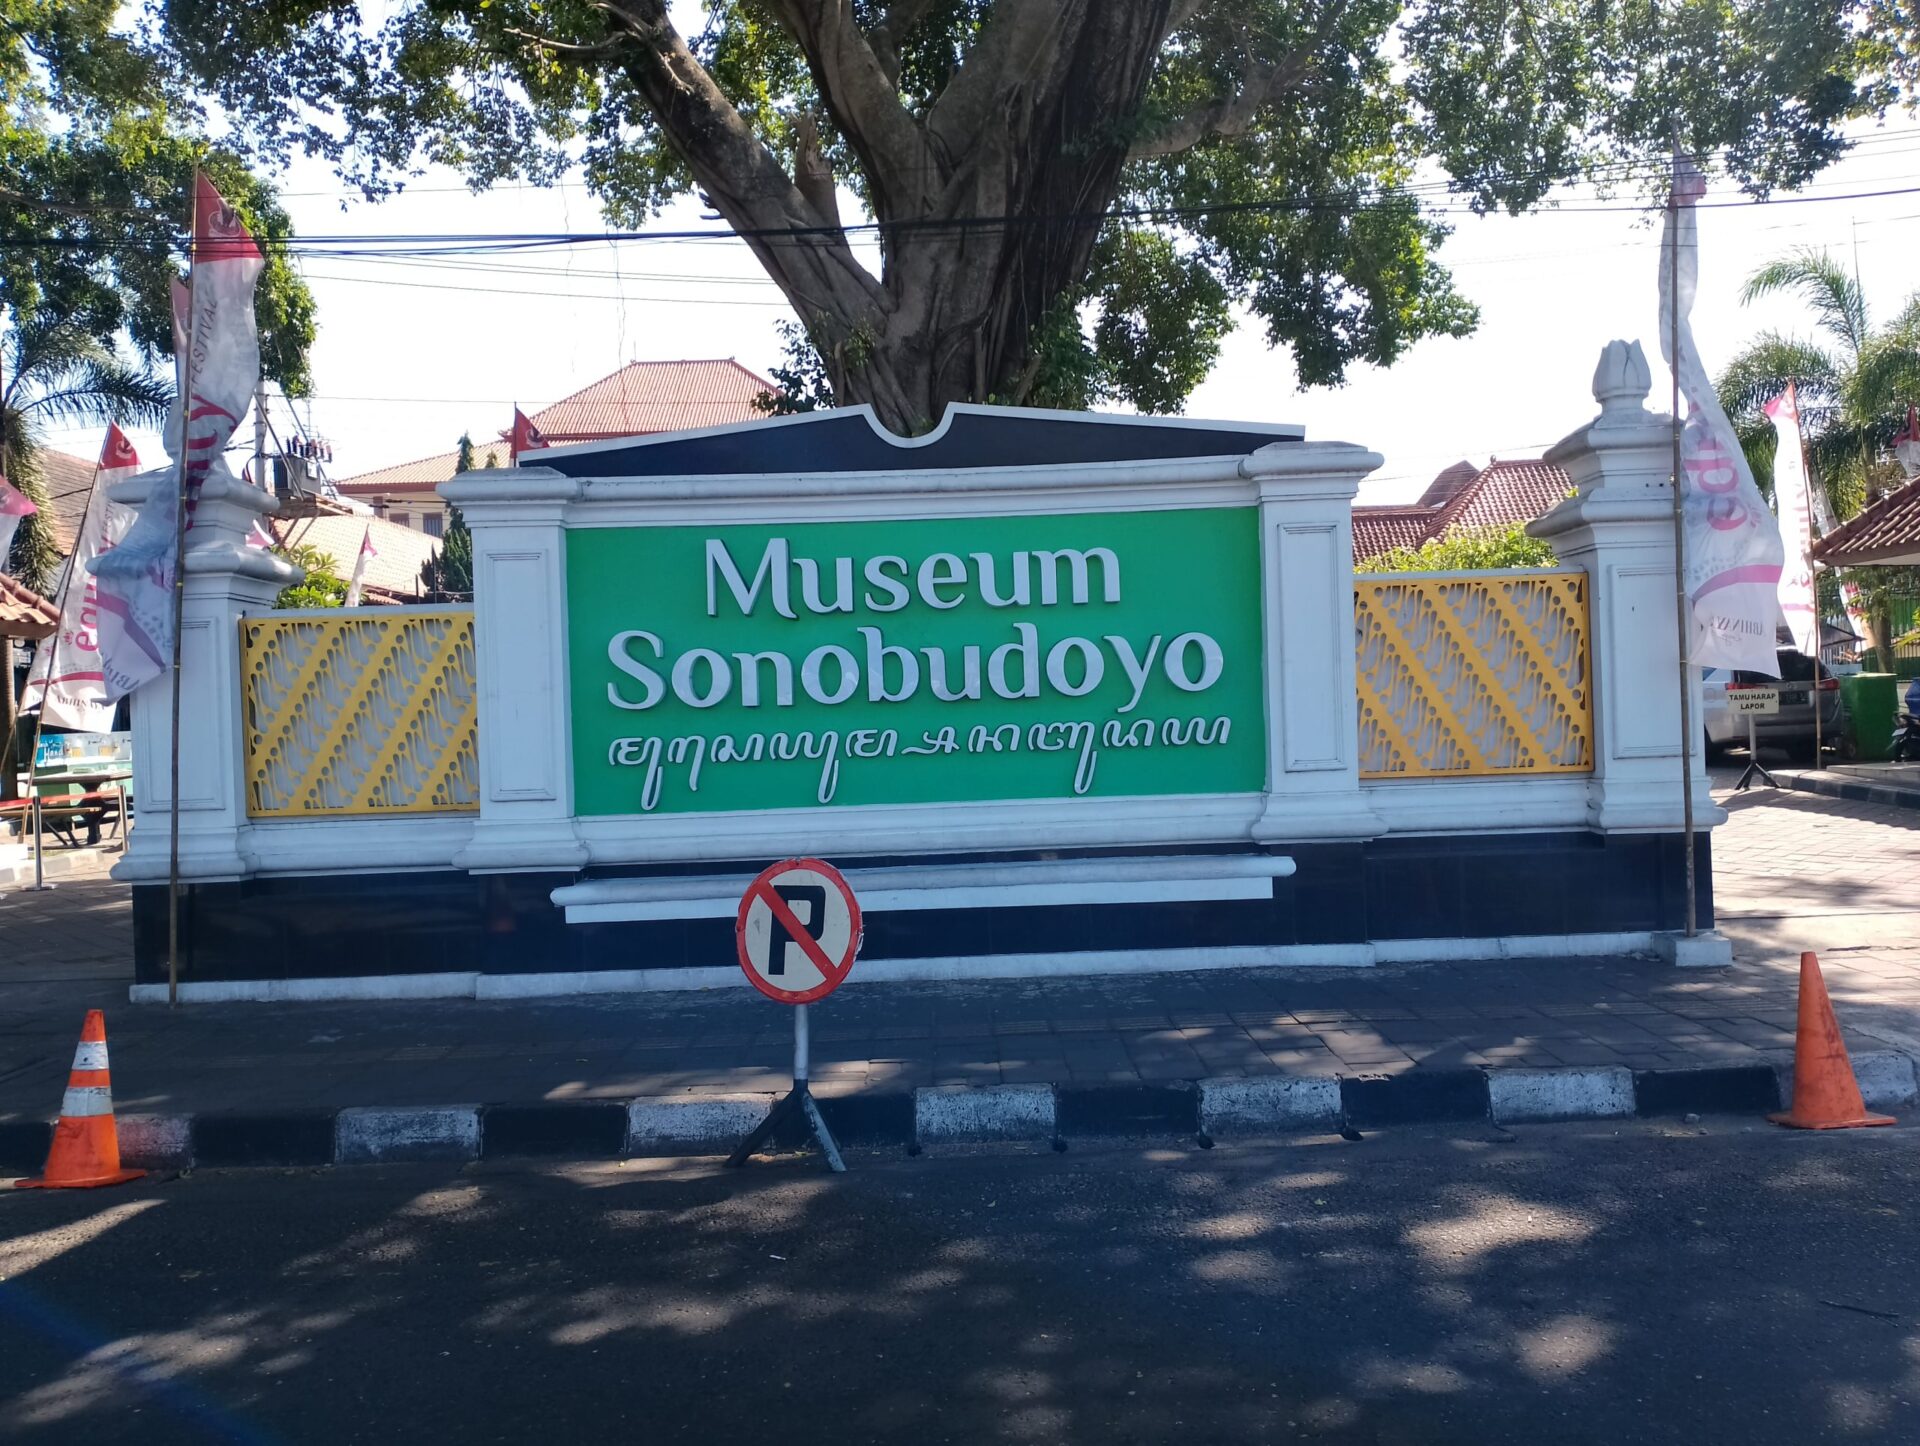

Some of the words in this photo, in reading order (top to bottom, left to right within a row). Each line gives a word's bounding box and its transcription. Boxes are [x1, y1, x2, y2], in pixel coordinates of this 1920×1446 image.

[705, 537, 1121, 618] Museum
[607, 623, 1224, 712] Sonobudoyo
[768, 885, 826, 975] P
